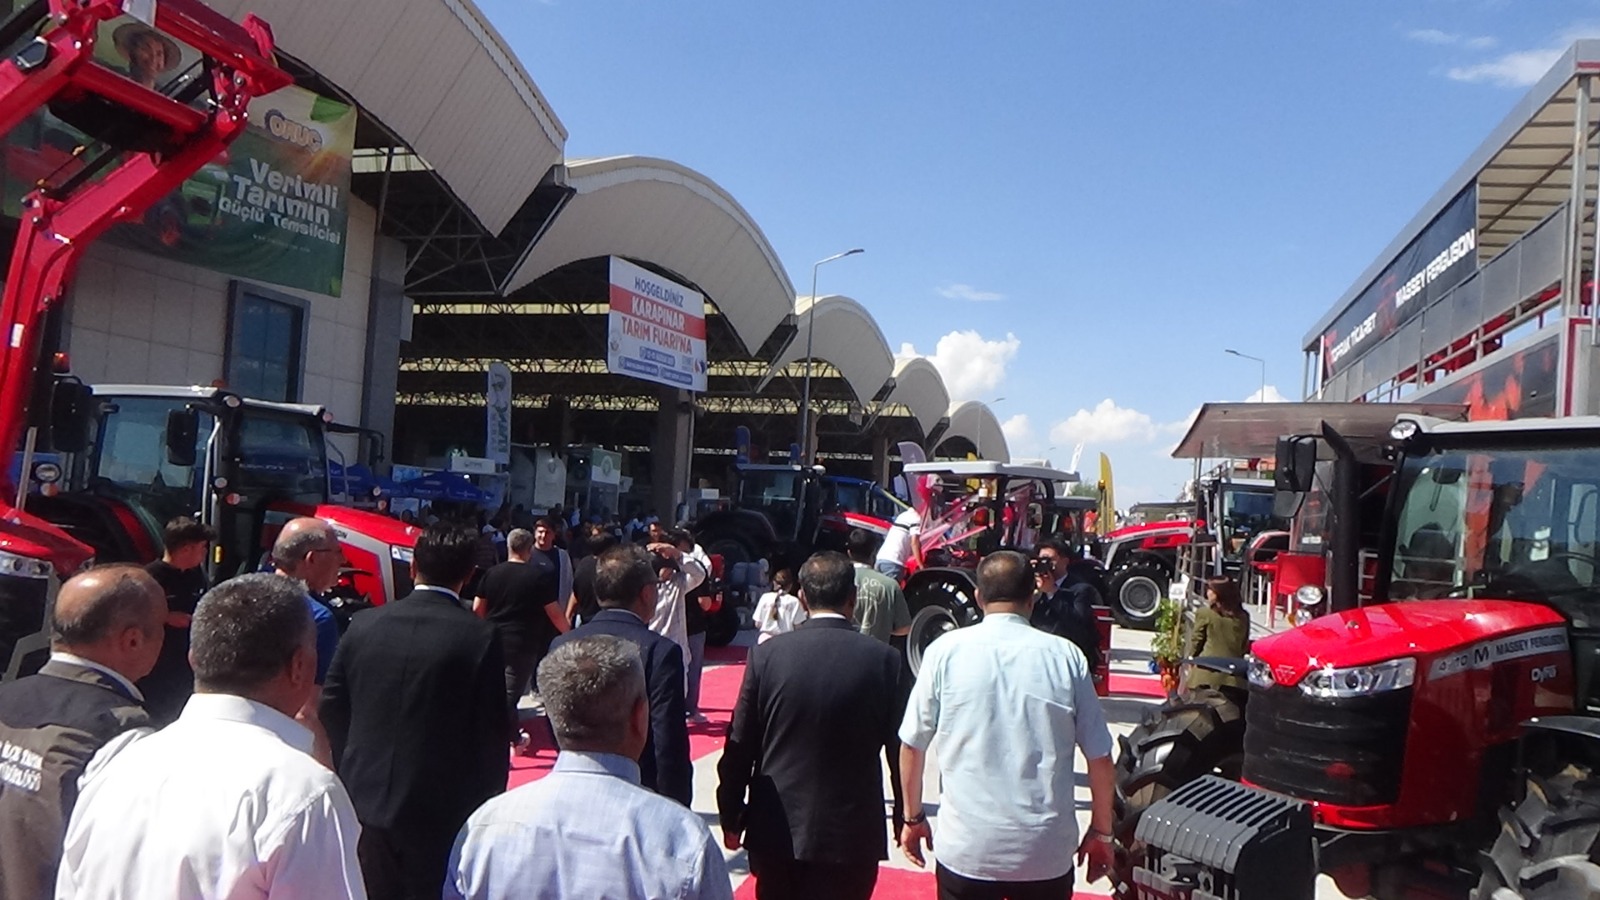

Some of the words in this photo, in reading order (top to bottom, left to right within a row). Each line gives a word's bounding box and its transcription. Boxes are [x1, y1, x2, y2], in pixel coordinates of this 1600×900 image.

[233, 174, 330, 226] Tarımın
[250, 157, 339, 208] Verimli
[218, 196, 265, 223] Güçlü
[270, 212, 341, 244] Temsilcisi
[1395, 269, 1426, 308] MASSEY
[1427, 228, 1475, 283] FERGUSON
[632, 295, 685, 331] KARAPINAR
[634, 276, 684, 308] HOŞGELDİNİZ
[621, 316, 650, 341] TARIM
[1474, 646, 1489, 664] M
[1496, 640, 1528, 655] MASSEY
